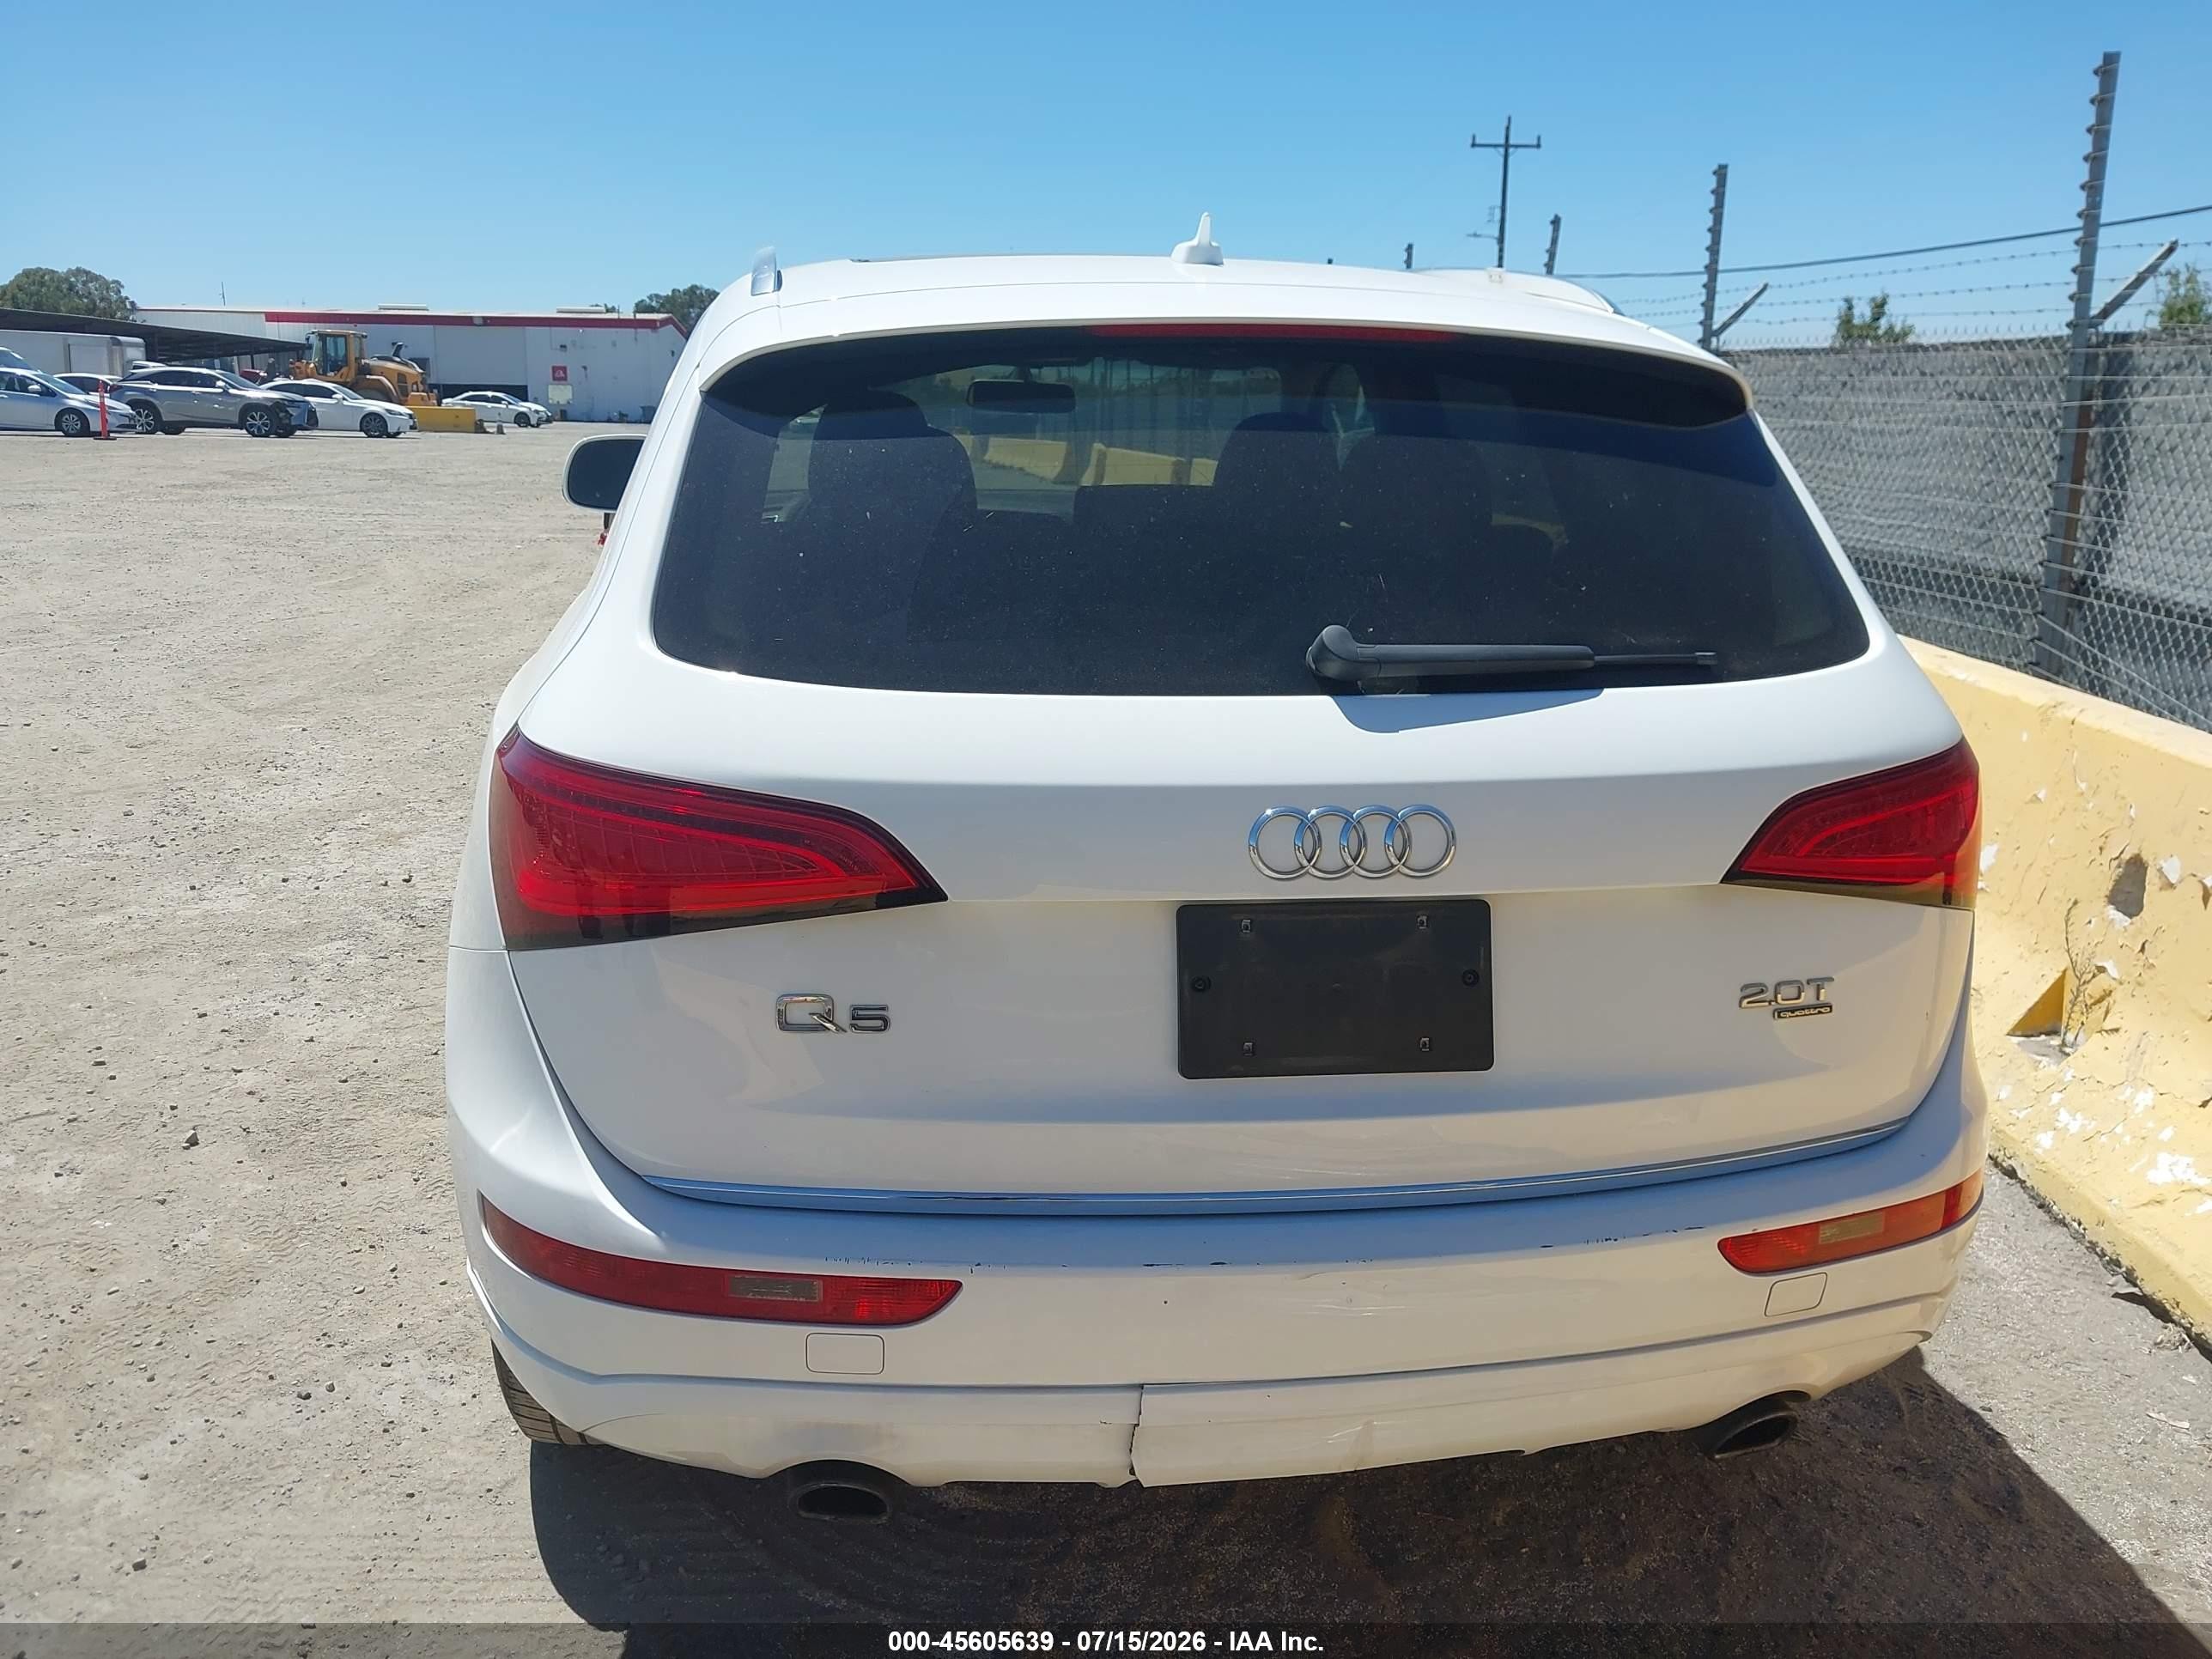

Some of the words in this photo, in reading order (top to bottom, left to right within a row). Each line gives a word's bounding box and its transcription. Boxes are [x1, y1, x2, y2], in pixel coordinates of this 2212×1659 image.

[1739, 976, 1834, 1008] 2.0T
[775, 994, 890, 1033] Q5
[1779, 1006, 1831, 1018] quattro
